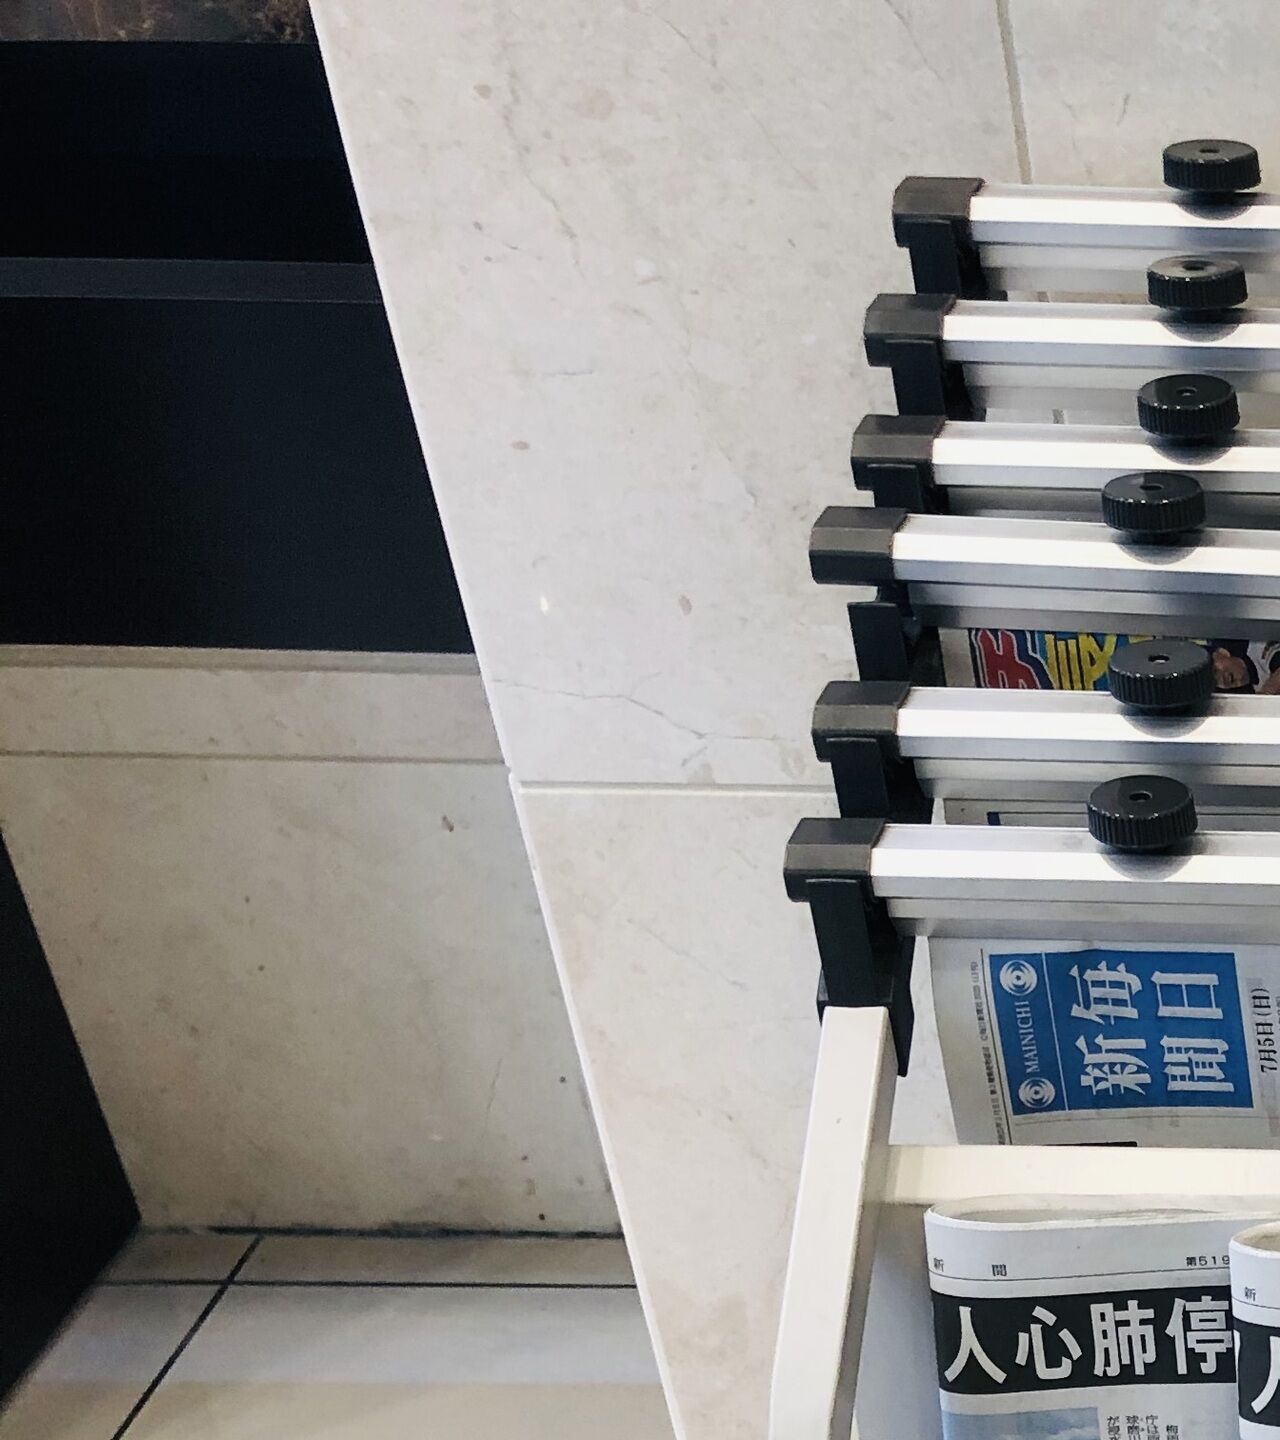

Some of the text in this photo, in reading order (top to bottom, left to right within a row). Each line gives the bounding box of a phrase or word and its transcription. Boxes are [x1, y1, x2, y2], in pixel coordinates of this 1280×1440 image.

[1013, 1000, 1041, 1074] MAINICHI
[1250, 987, 1278, 1074] 7月5日(日)
[944, 1295, 1235, 1386] 人心肺停
